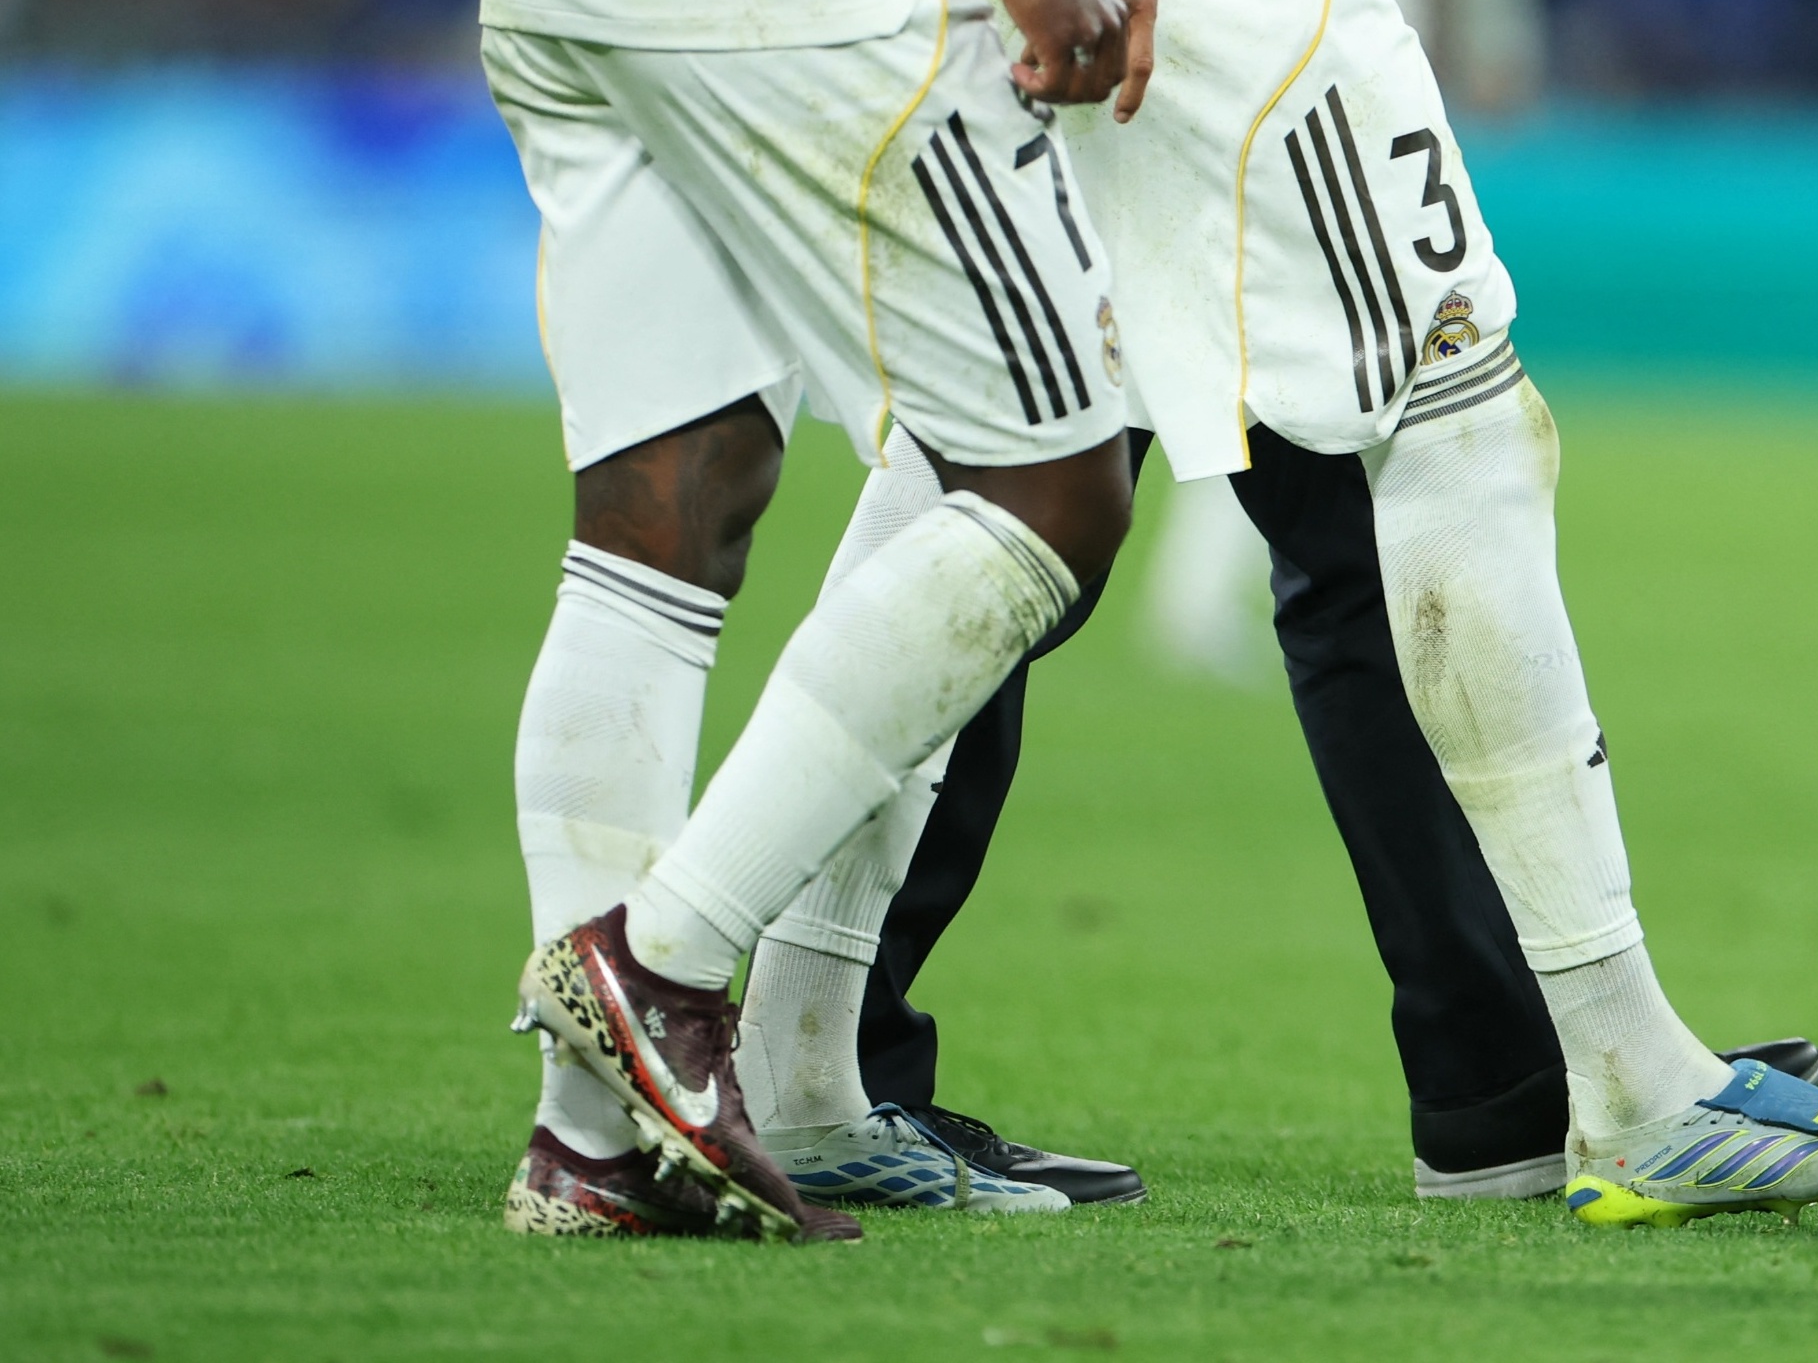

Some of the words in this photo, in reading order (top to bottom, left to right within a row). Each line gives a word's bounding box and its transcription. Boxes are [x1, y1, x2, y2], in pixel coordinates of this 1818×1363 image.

[1013, 131, 1093, 274] 7
[1389, 126, 1467, 273] 3
[1744, 1070, 1765, 1090] 1994
[1634, 1144, 1673, 1174] PREDATOR
